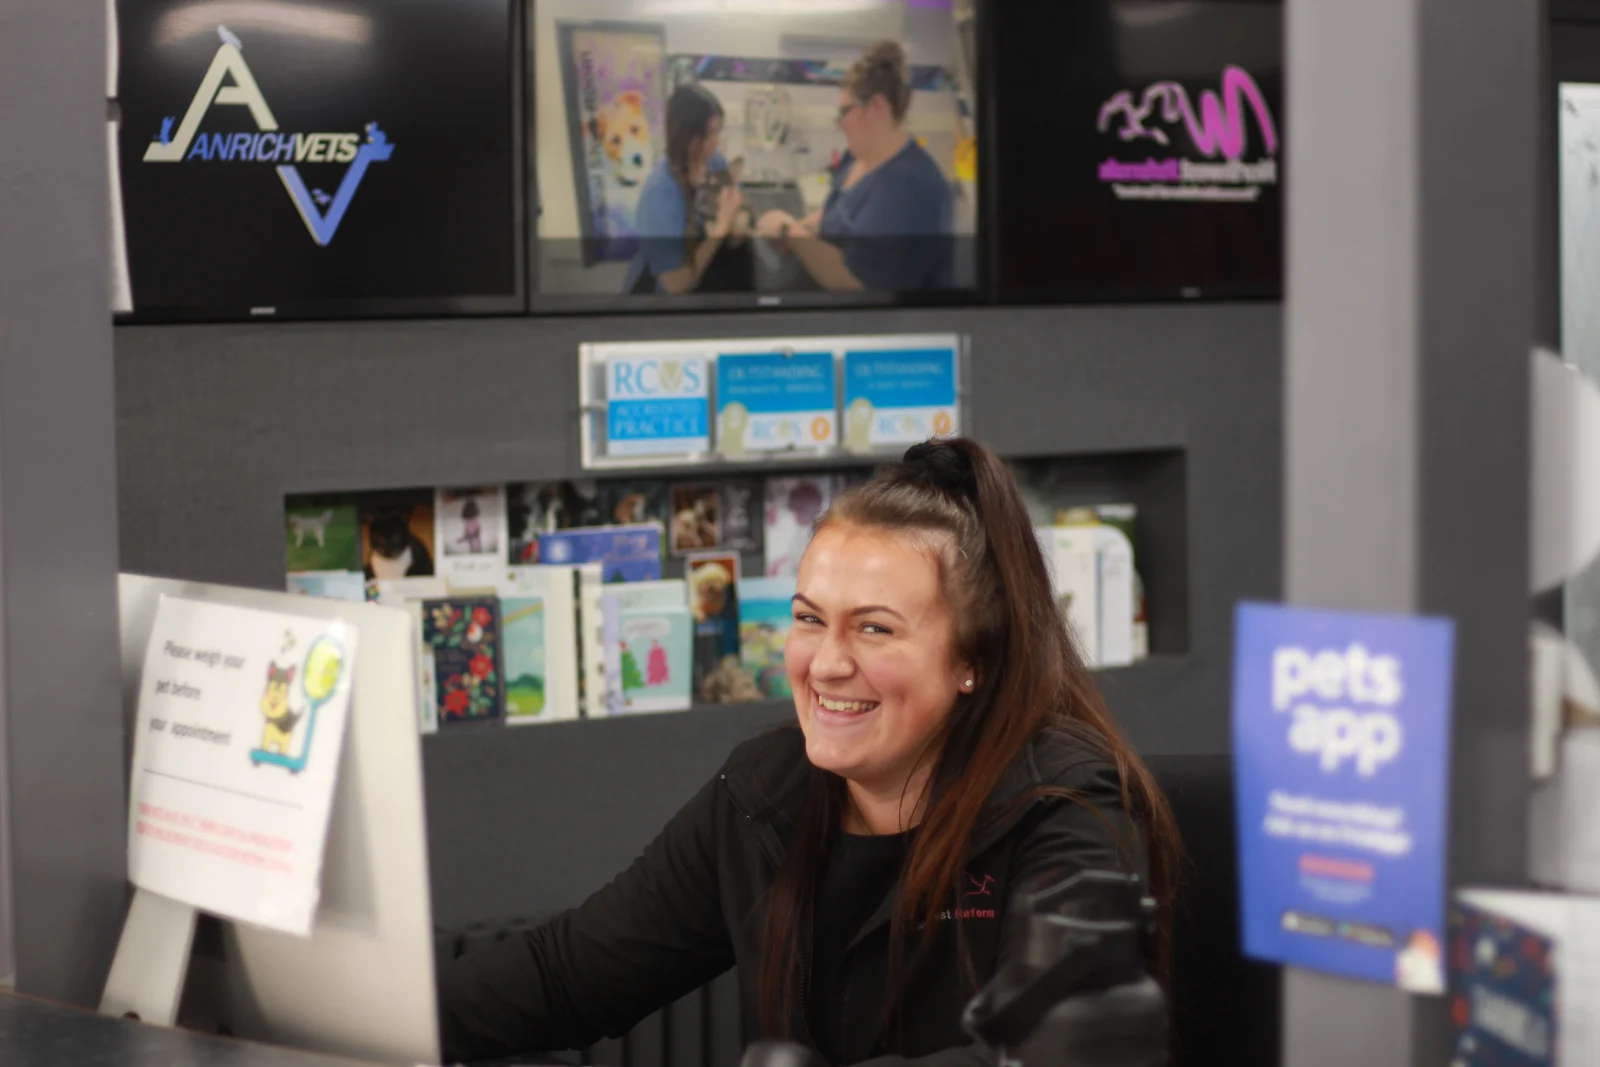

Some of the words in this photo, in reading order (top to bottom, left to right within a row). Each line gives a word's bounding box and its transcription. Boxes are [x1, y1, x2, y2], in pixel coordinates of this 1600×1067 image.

[187, 132, 360, 163] ANRICHVETS
[613, 358, 702, 395] RCVS
[164, 639, 191, 660] Please
[193, 648, 221, 668] weigh
[223, 655, 247, 669] your
[154, 680, 170, 697] pet
[171, 680, 202, 700] before
[1272, 639, 1404, 712] pets
[149, 716, 168, 733] your
[171, 721, 233, 745] appointment
[1287, 702, 1403, 778] app
